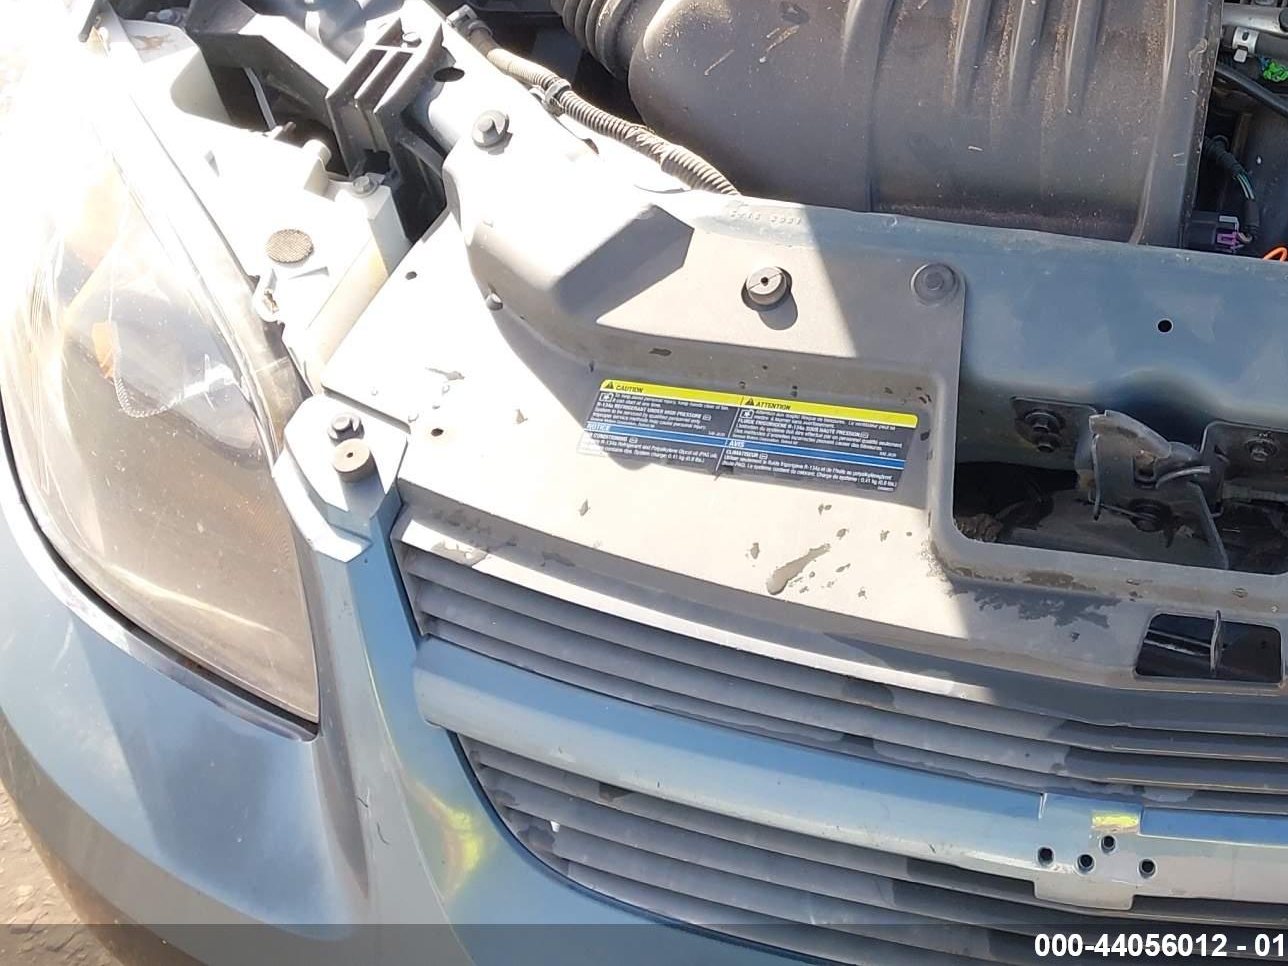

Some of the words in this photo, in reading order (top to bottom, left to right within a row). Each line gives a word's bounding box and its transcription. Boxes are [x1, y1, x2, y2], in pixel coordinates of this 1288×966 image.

[614, 384, 644, 393] CAUTION
[755, 400, 791, 411] ATTENTION
[585, 422, 610, 431] NOTICE
[727, 440, 745, 448] AVIS
